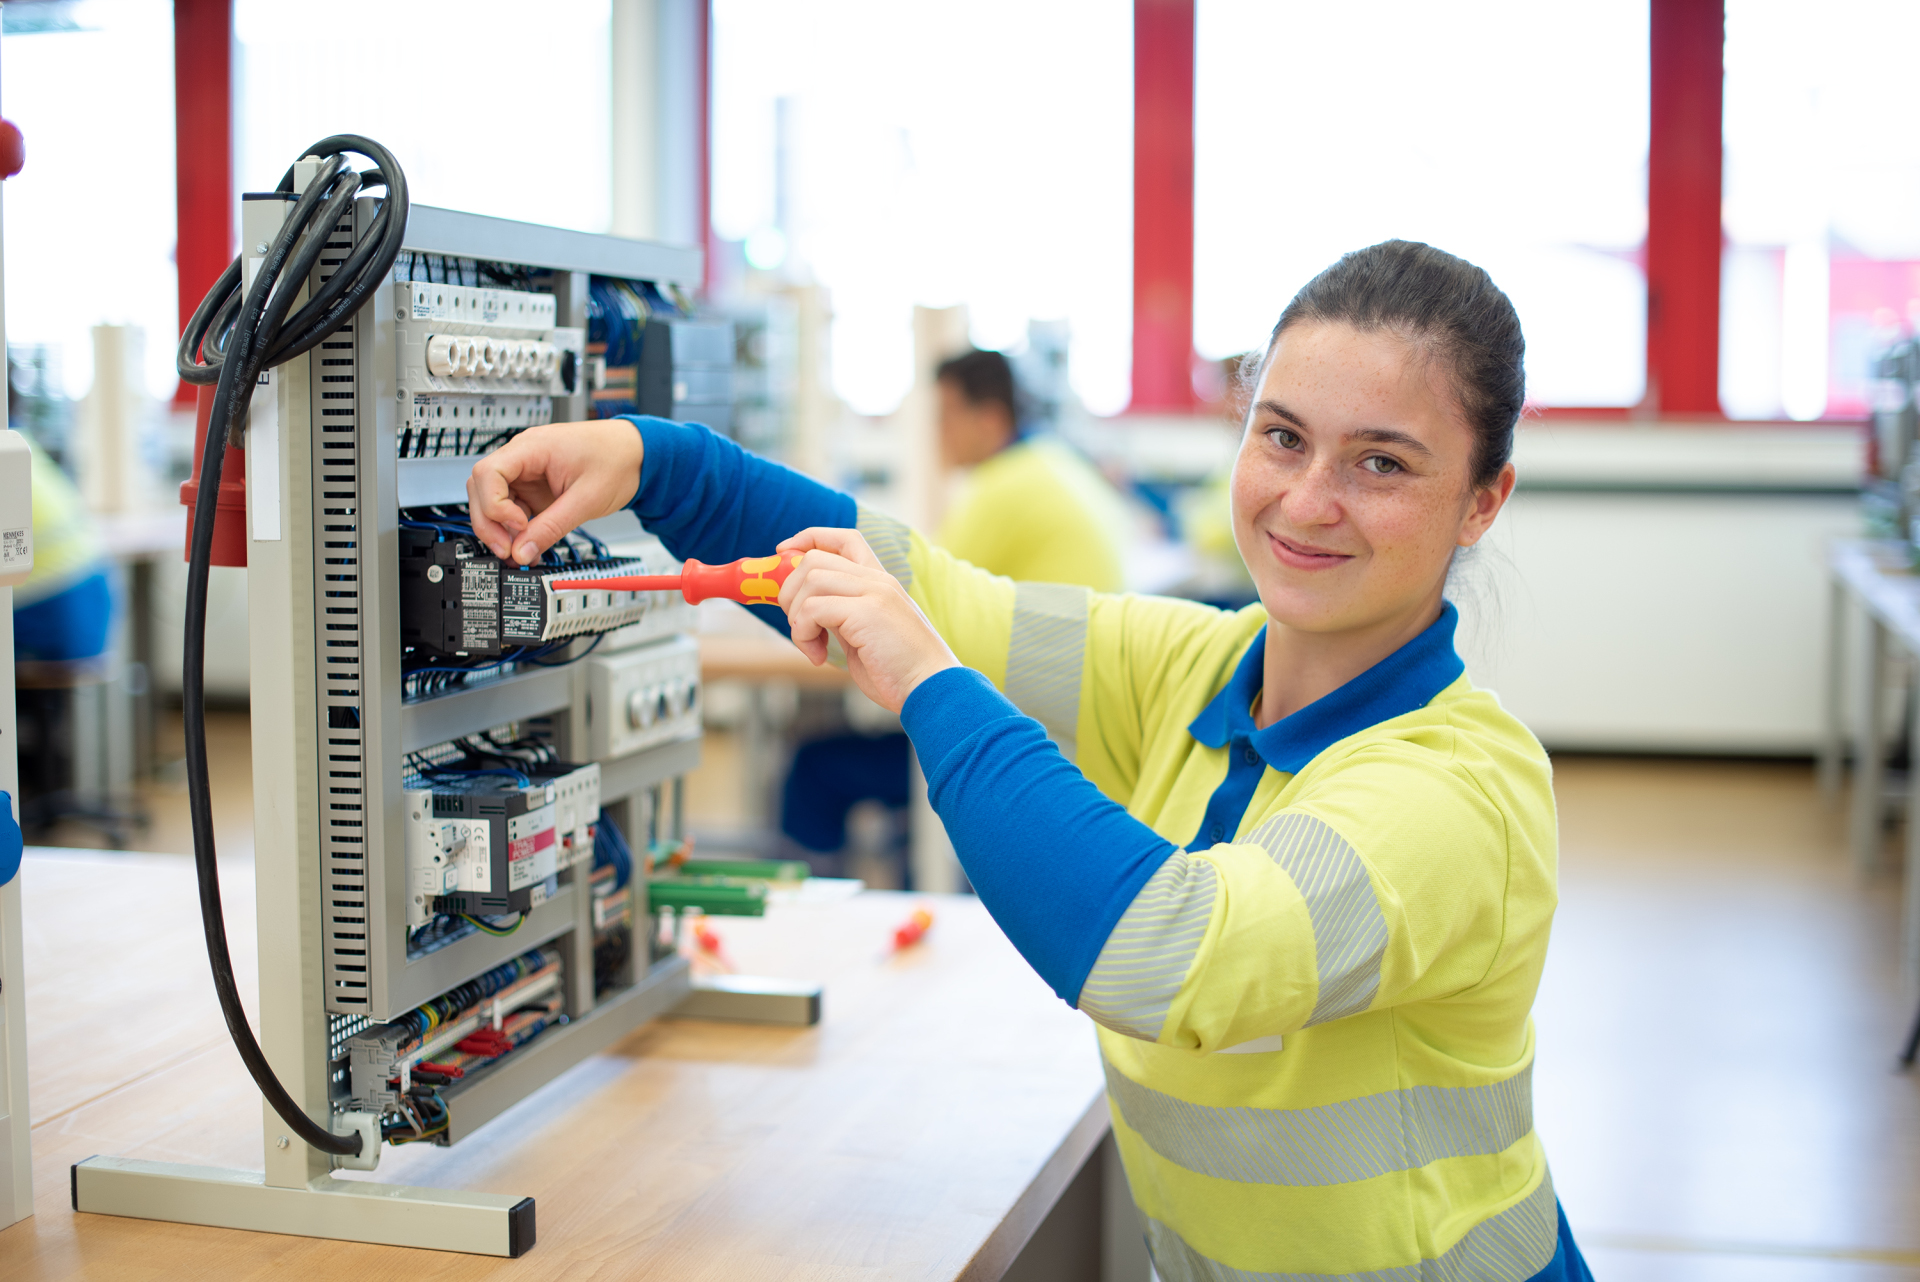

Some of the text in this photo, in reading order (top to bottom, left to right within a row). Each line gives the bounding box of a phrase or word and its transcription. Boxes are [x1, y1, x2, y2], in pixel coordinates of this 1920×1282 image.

[270, 247, 286, 271] GENERAL
[327, 298, 352, 320] GENERAL
[507, 574, 530, 583] MOELLER
